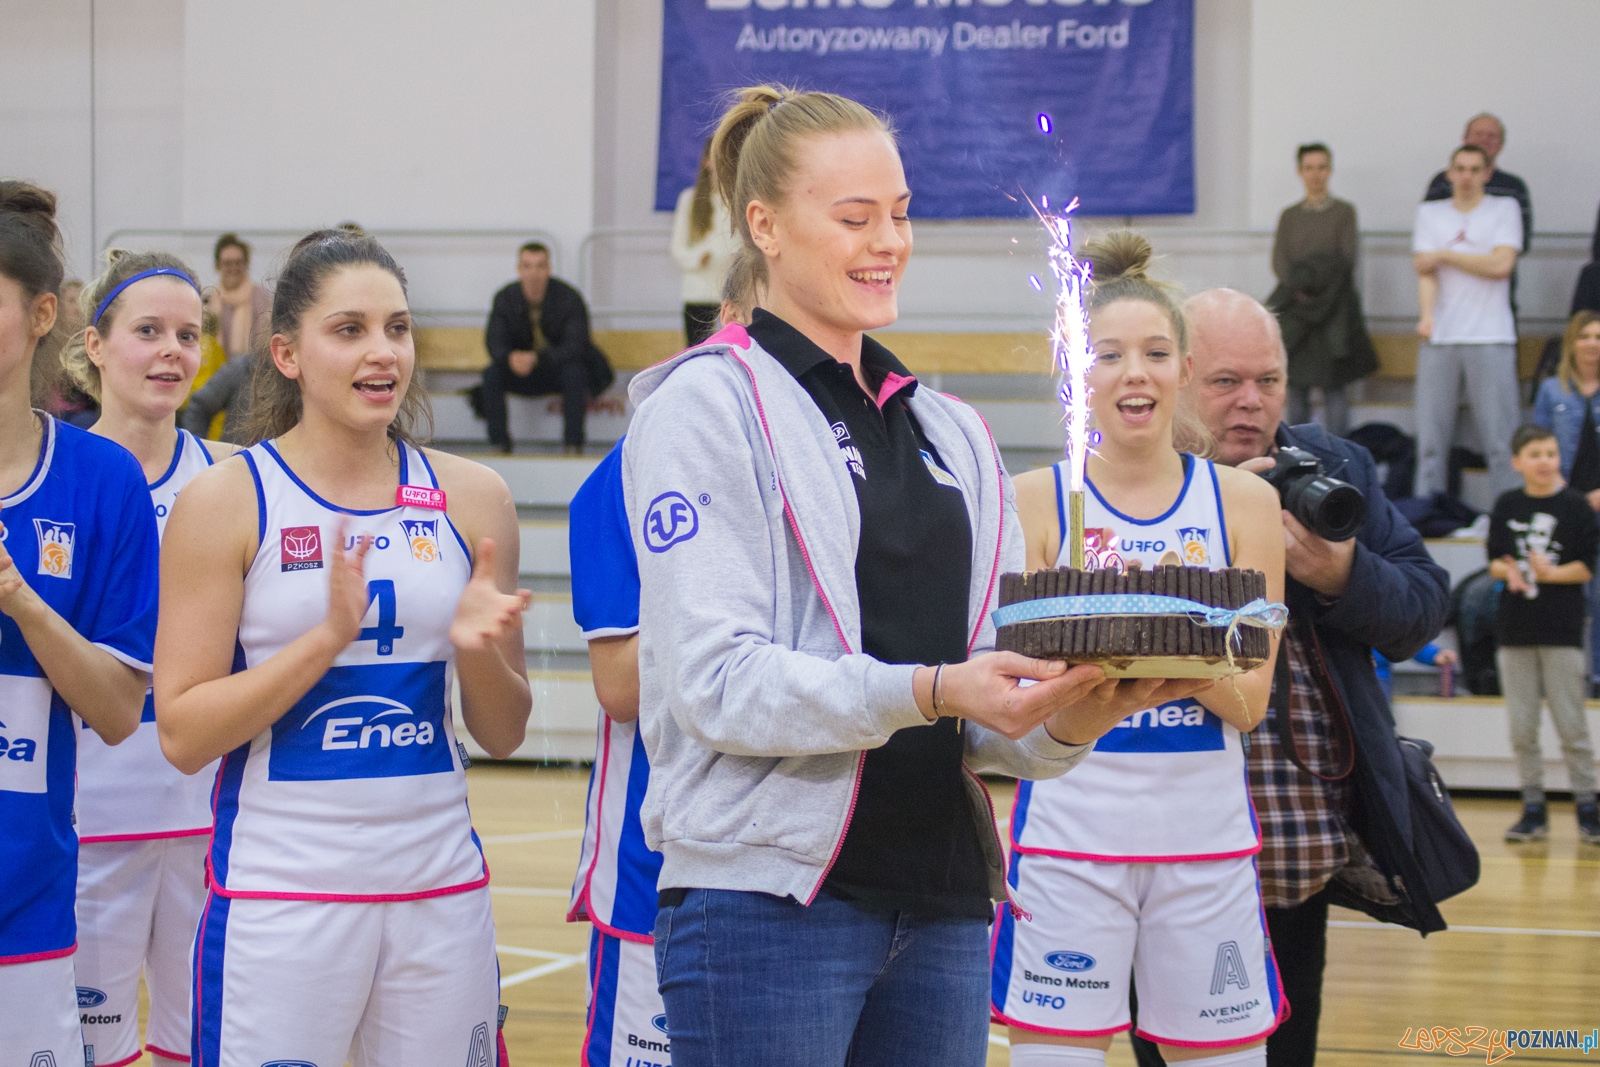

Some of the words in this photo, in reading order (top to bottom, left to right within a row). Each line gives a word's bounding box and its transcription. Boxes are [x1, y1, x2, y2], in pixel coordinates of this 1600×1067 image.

[735, 23, 948, 56] Autoryzowany
[953, 21, 1052, 50] Dealer
[1057, 18, 1129, 48] Ford
[287, 562, 319, 570] PZKOSZ
[354, 579, 404, 656] 4
[1115, 705, 1205, 728] nea
[321, 716, 435, 751] Enea
[1051, 953, 1089, 970] Ford
[1024, 969, 1062, 986] Bemo
[1065, 977, 1110, 989] Motors
[1199, 998, 1260, 1018] AVENIDA
